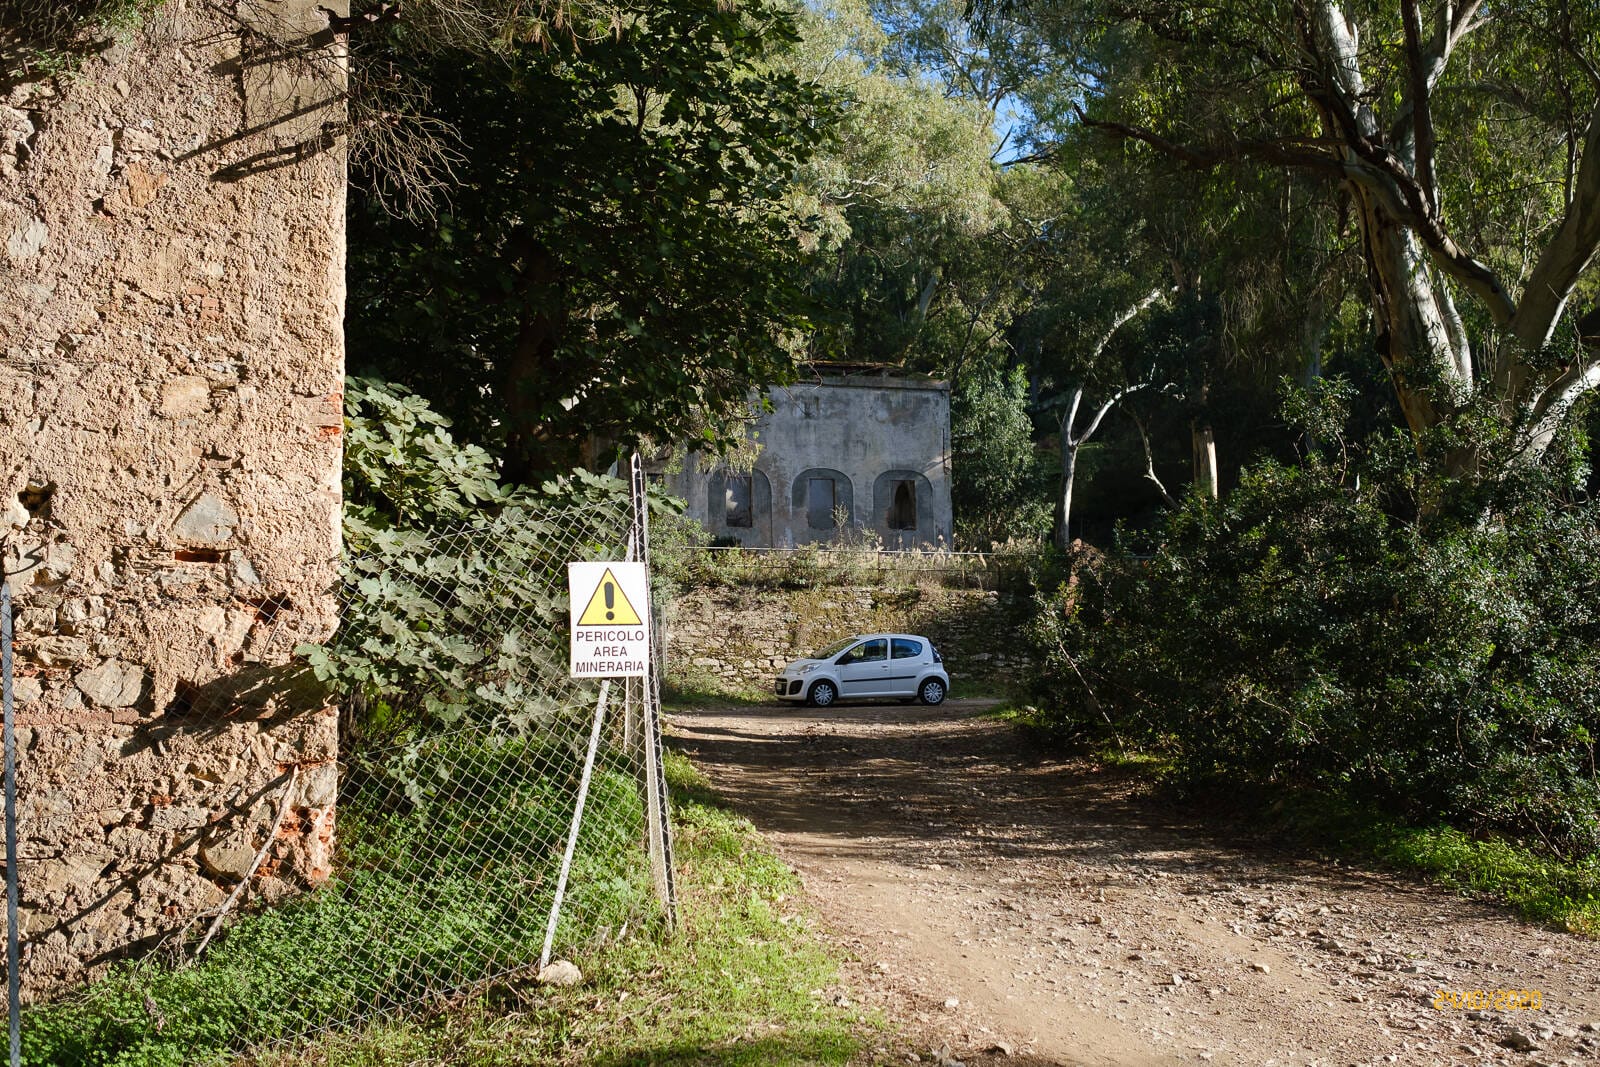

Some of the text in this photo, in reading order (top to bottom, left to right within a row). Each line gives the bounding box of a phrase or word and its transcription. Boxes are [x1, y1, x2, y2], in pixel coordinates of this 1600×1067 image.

[576, 630, 645, 642] PERICOLO
[593, 646, 628, 657] AREA
[575, 661, 644, 673] MINERARIA
